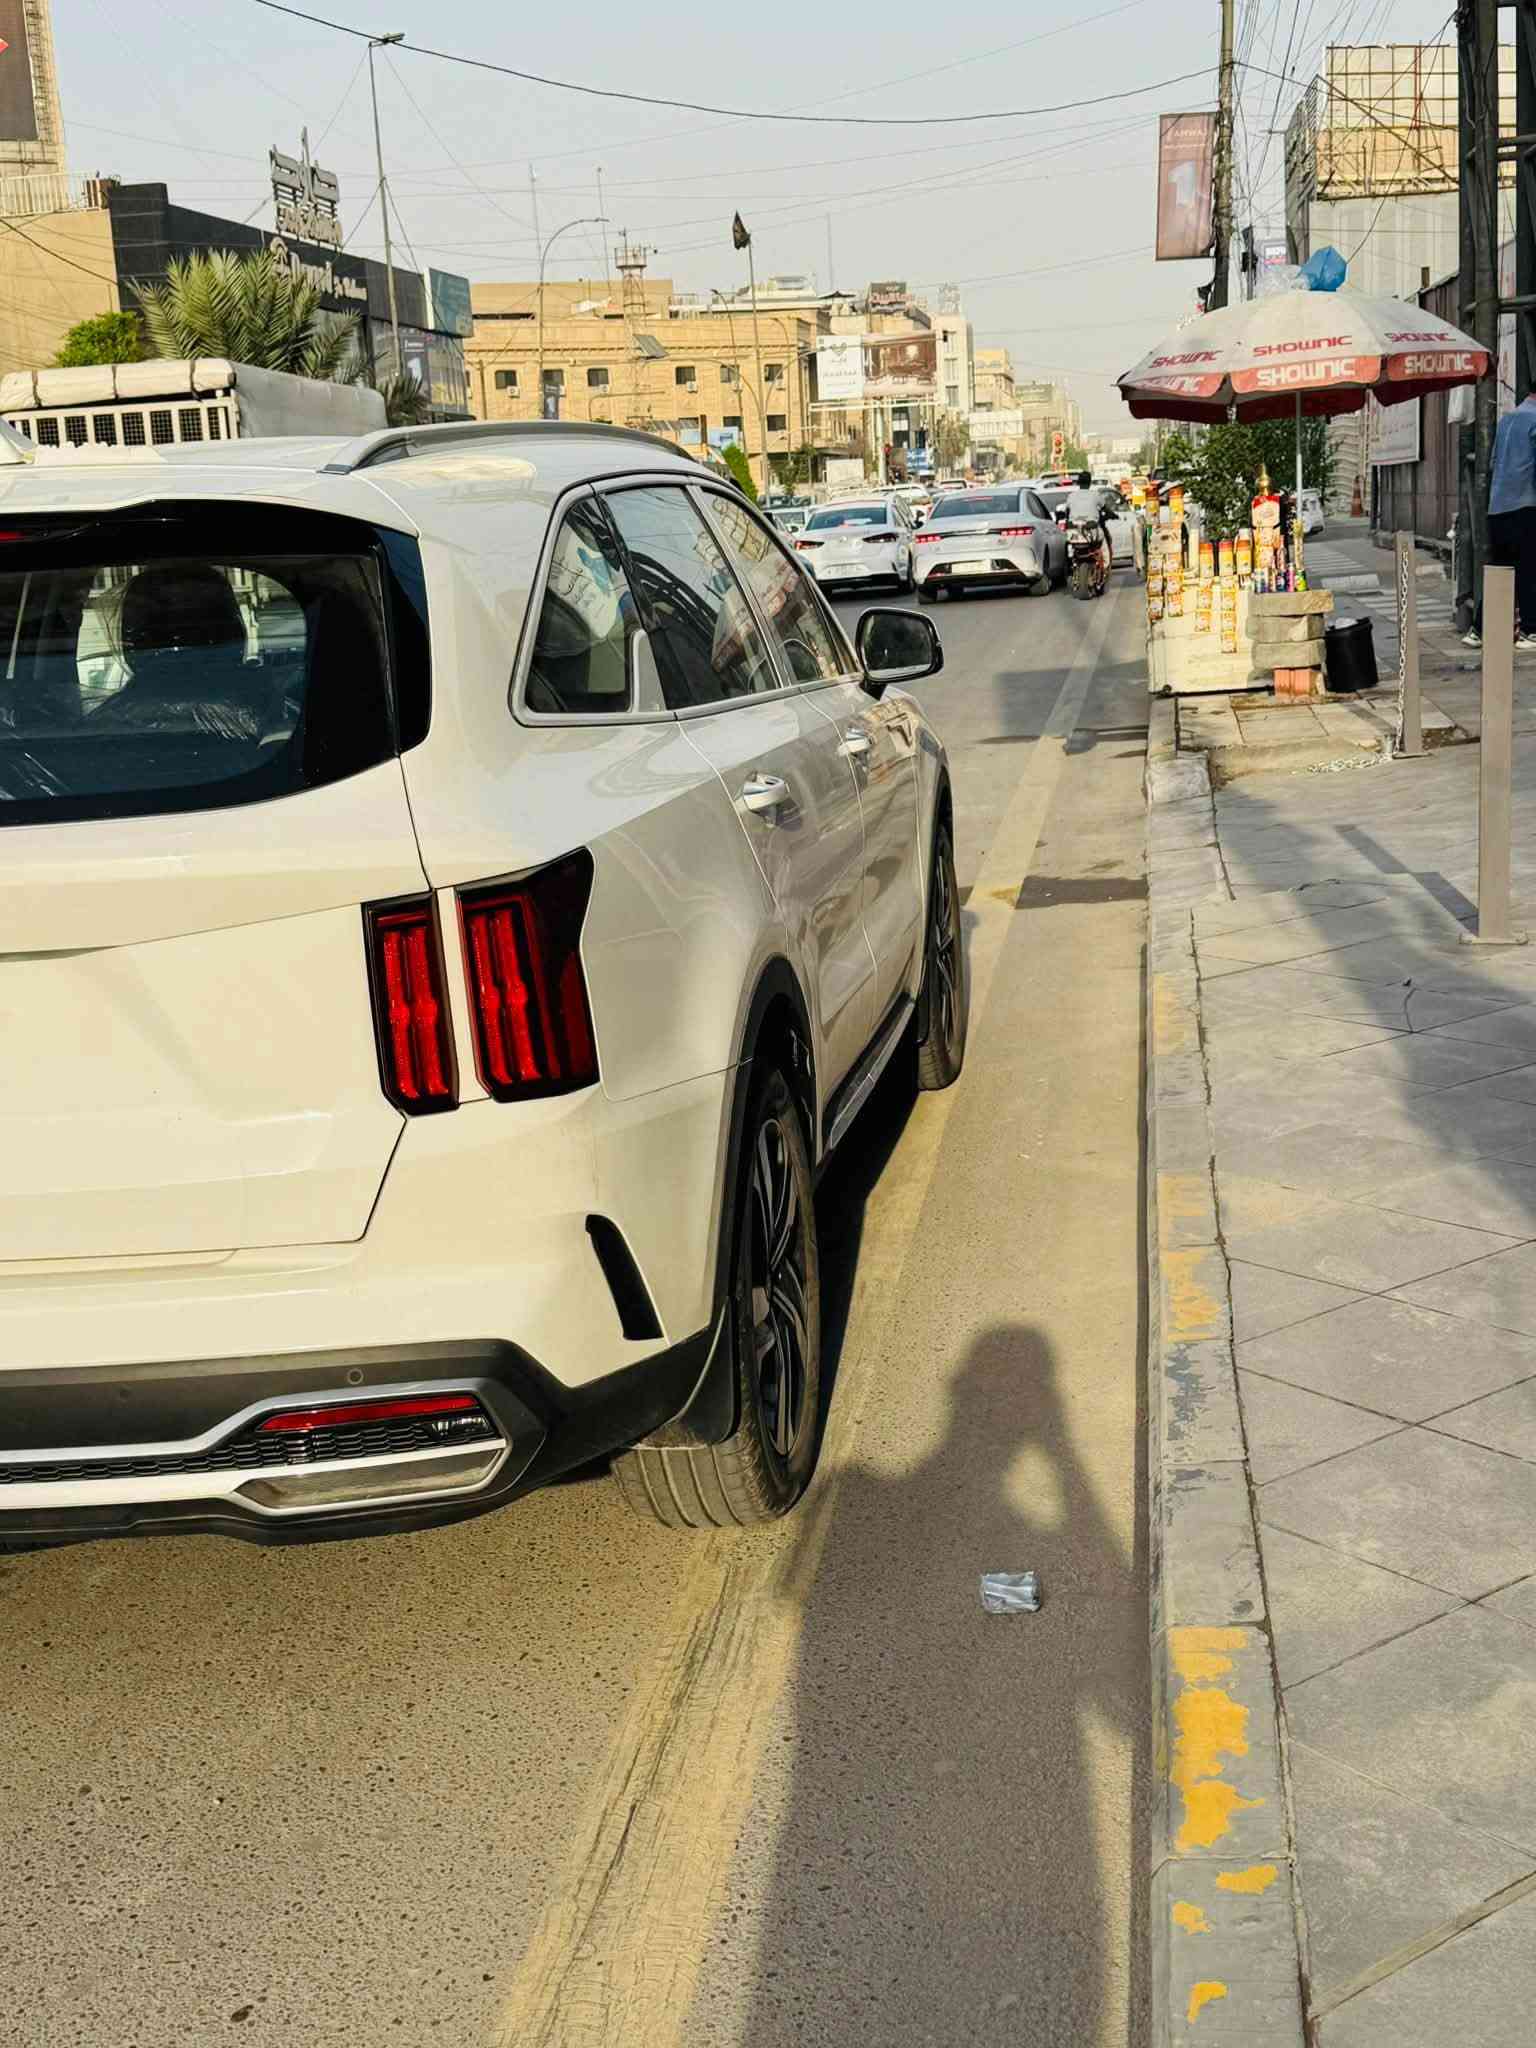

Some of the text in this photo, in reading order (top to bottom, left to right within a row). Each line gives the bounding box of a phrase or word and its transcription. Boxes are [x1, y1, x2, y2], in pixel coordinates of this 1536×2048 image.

[1253, 335, 1352, 357] SHOWNIC
[1150, 350, 1223, 368] SHOWNIC
[1404, 353, 1474, 373] SHOWNIC
[1257, 358, 1356, 386] SHOWNIC
